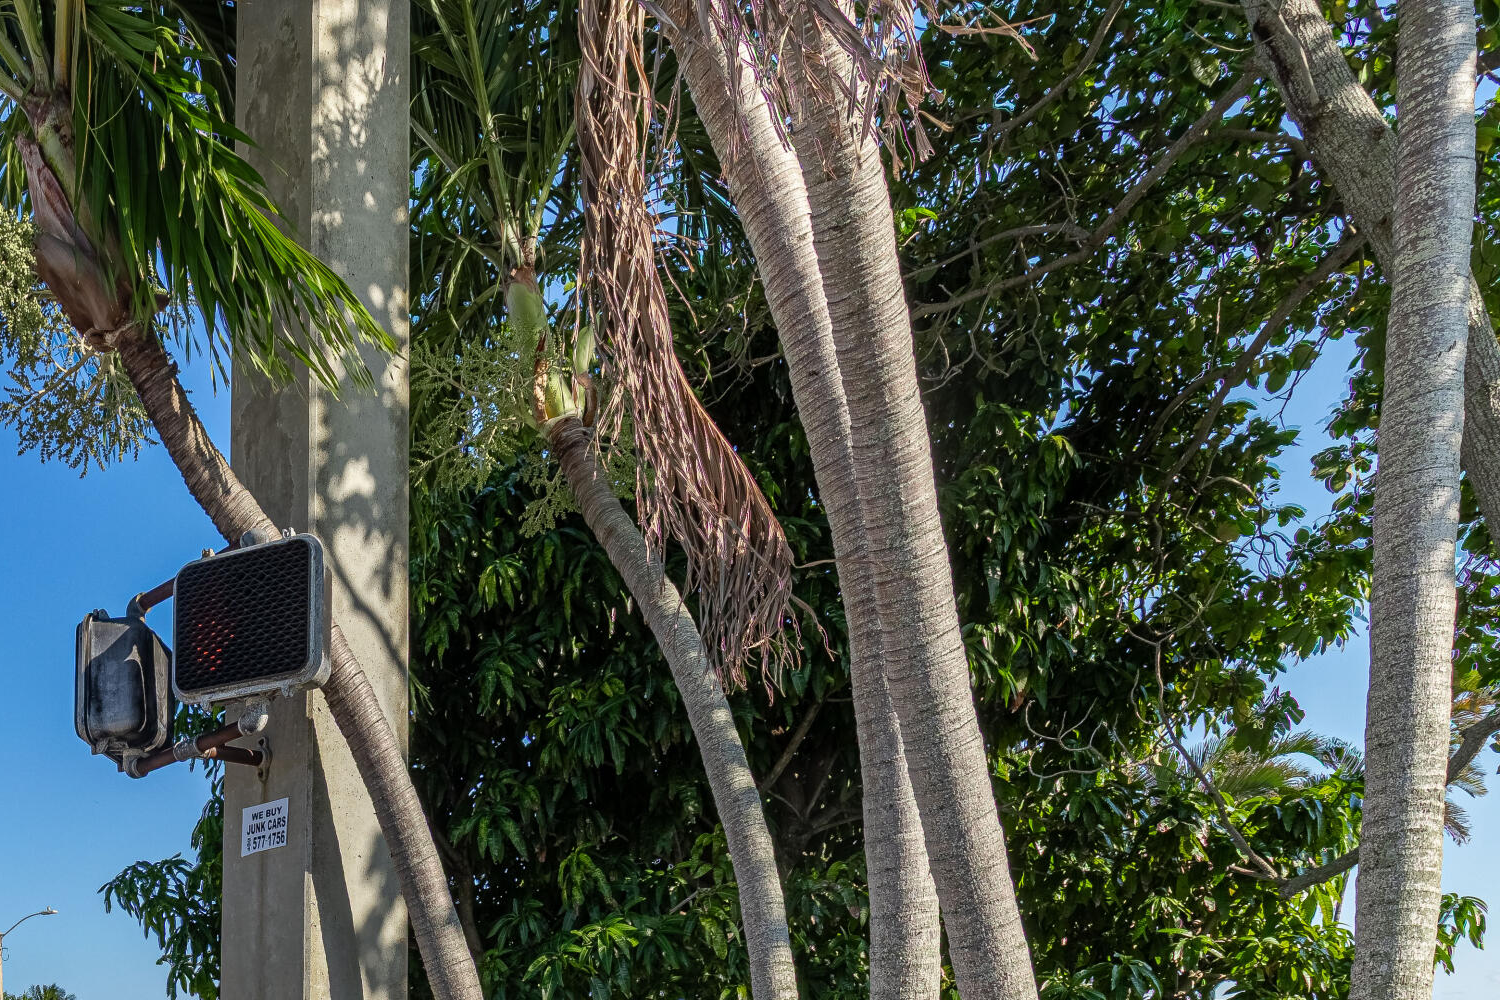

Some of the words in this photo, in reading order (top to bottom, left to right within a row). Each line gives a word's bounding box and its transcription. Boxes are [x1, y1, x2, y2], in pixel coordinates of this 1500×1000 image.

[252, 811, 263, 820] WE
[266, 806, 282, 817] BUY
[247, 821, 265, 835] JUNK
[268, 816, 286, 830] CARS
